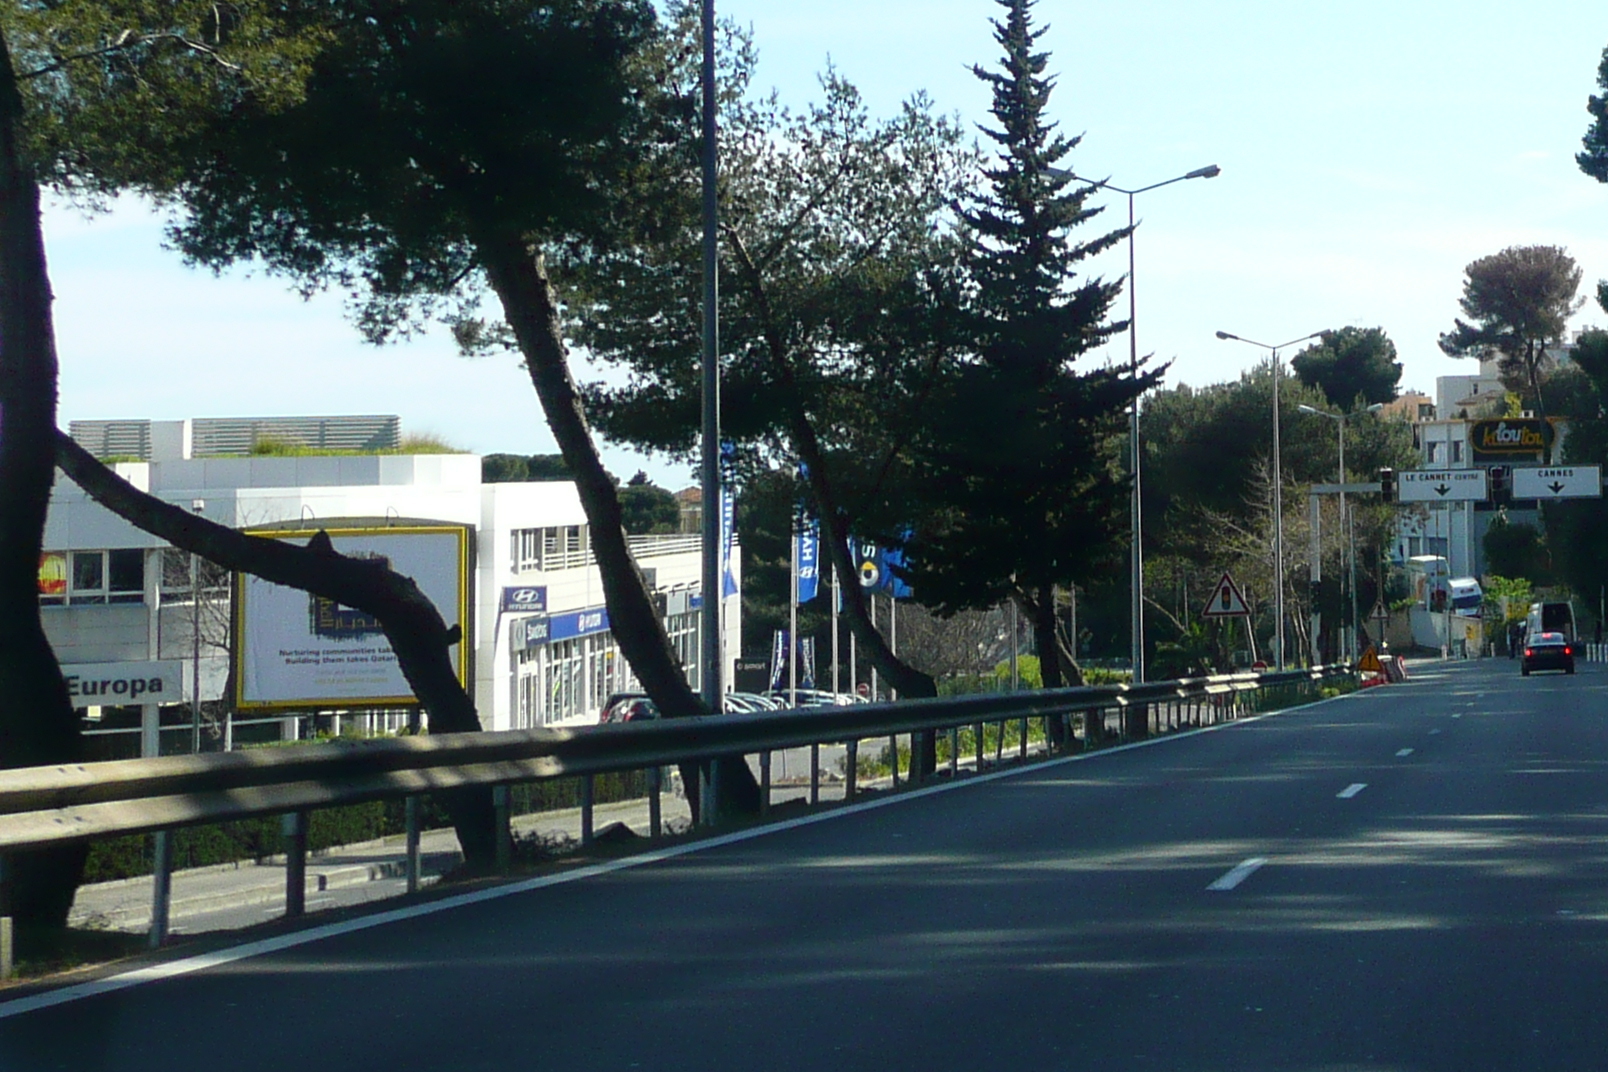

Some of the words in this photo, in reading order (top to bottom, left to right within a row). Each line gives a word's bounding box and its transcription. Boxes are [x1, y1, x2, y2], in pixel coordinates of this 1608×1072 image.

[1418, 473, 1451, 481] CANNET
[1538, 469, 1574, 478] CANNES
[66, 674, 163, 699] Europa
